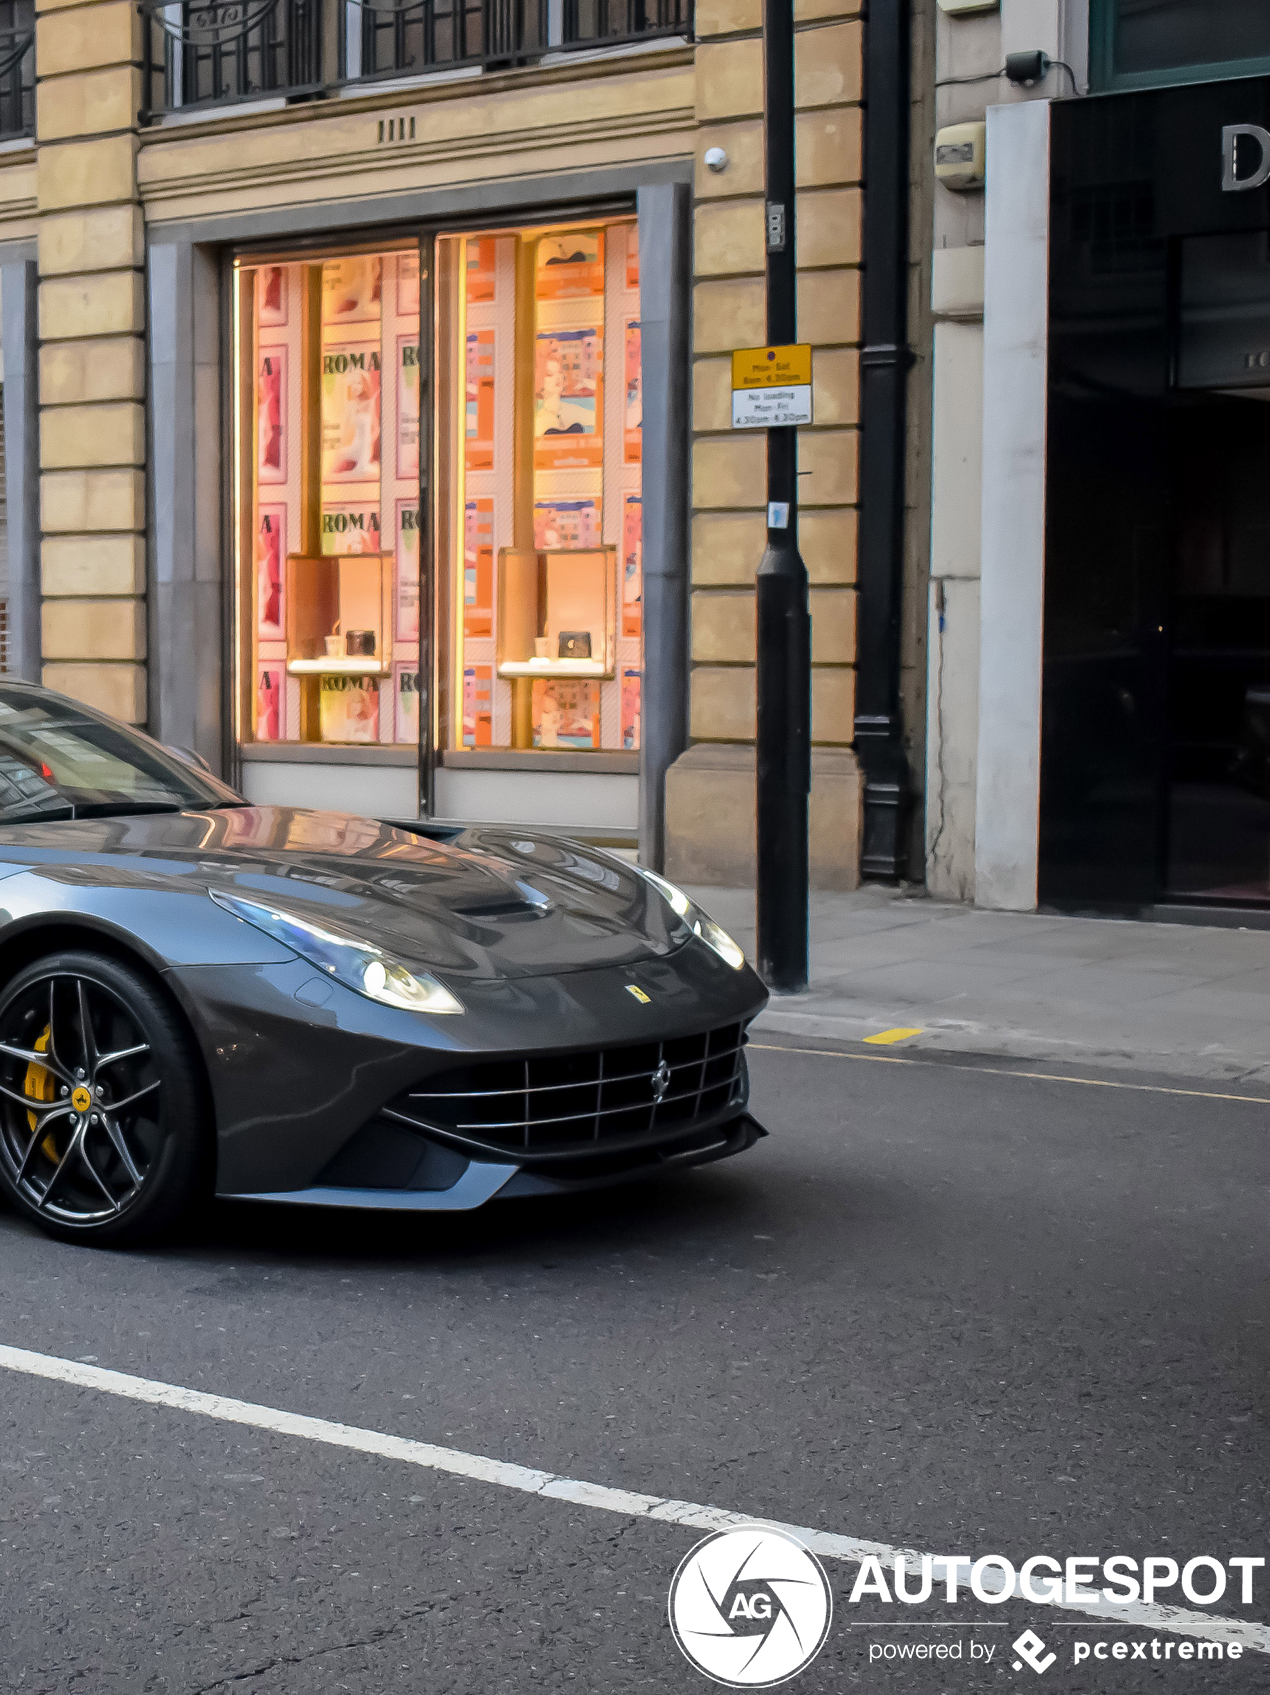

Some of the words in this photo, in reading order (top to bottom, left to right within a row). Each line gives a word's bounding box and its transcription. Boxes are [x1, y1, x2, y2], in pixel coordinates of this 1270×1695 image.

[1222, 123, 1270, 191] D
[323, 351, 380, 374] ROMA
[748, 393, 761, 401] No
[763, 392, 795, 401] loading
[322, 512, 380, 533] ROMA
[322, 676, 379, 691] ROMA
